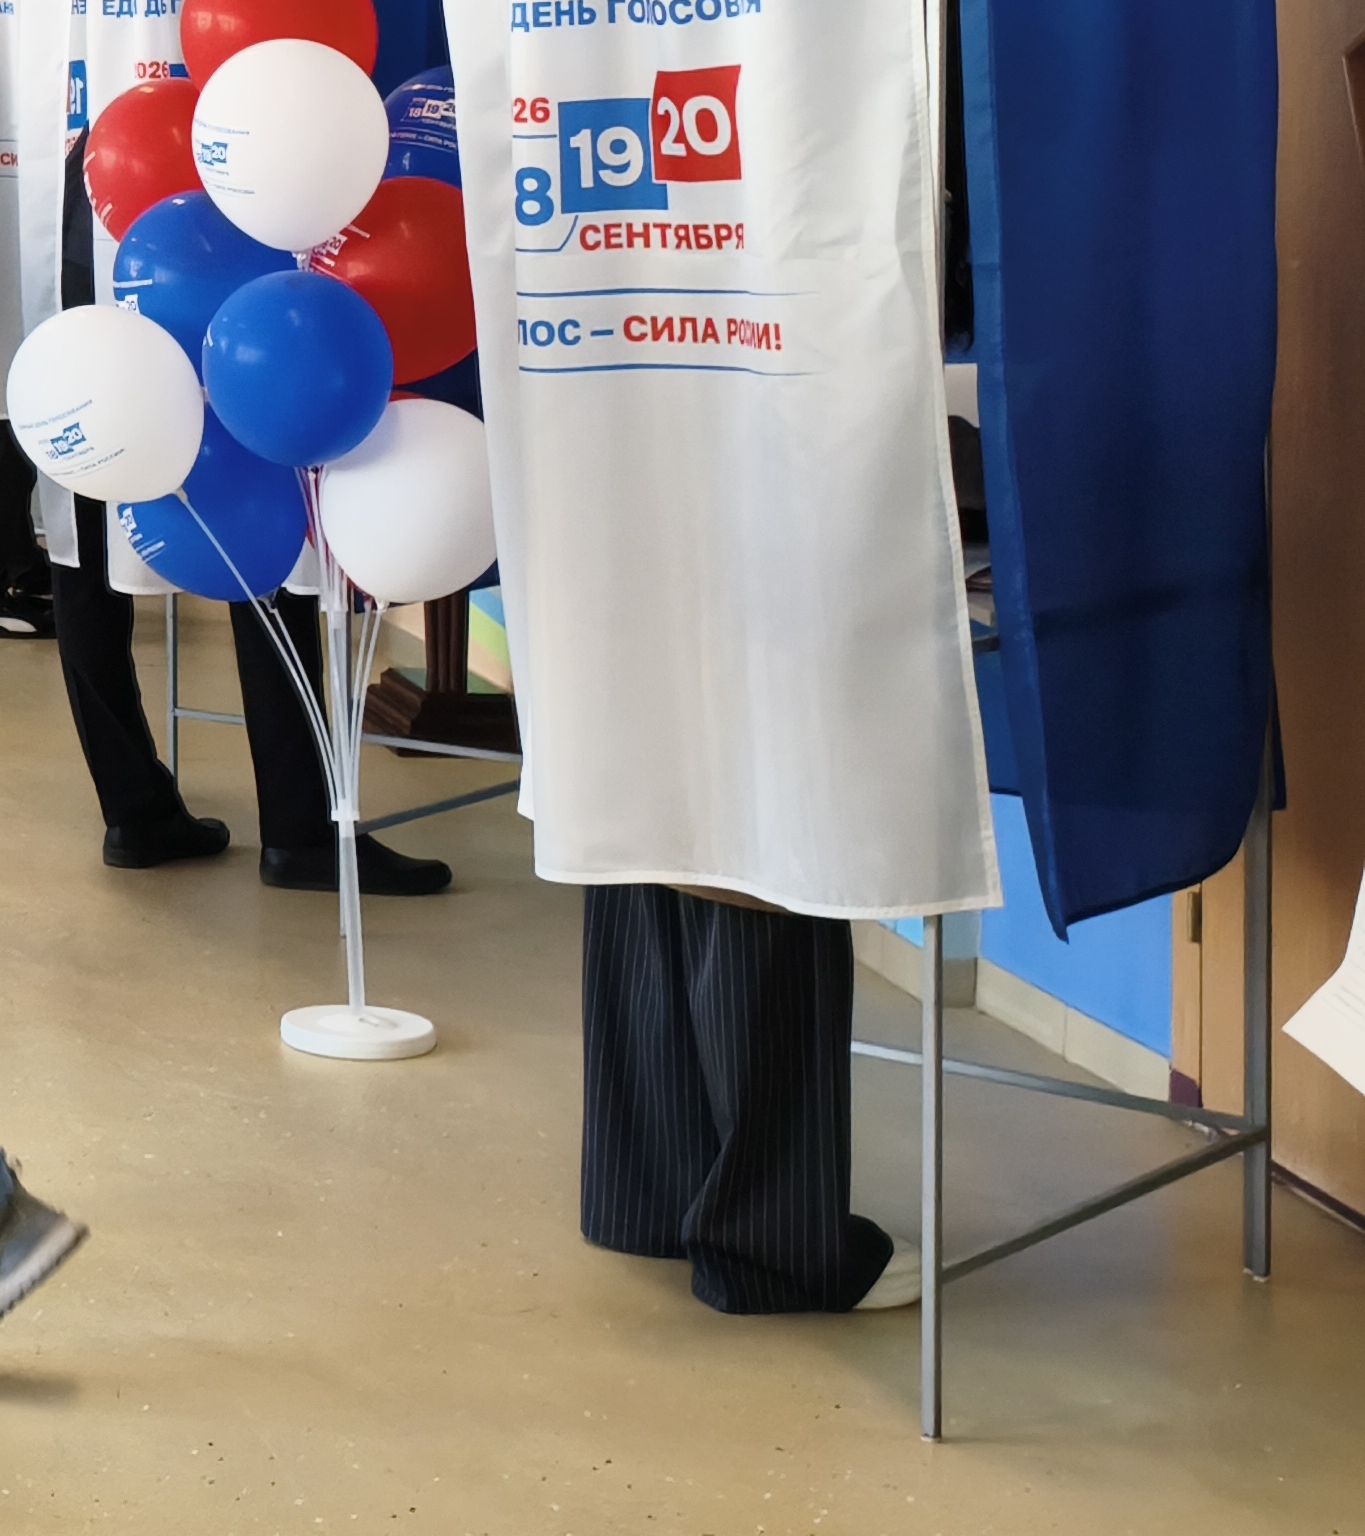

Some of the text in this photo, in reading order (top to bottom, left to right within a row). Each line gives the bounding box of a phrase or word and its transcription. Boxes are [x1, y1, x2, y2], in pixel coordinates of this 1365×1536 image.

[511, 0, 597, 32] ДЕНЬ
[134, 61, 168, 79] 026
[570, 126, 645, 189] 19
[657, 95, 732, 157] 20
[579, 222, 745, 252] СЕНТЯБРЯ
[623, 315, 720, 344] СИЛА
